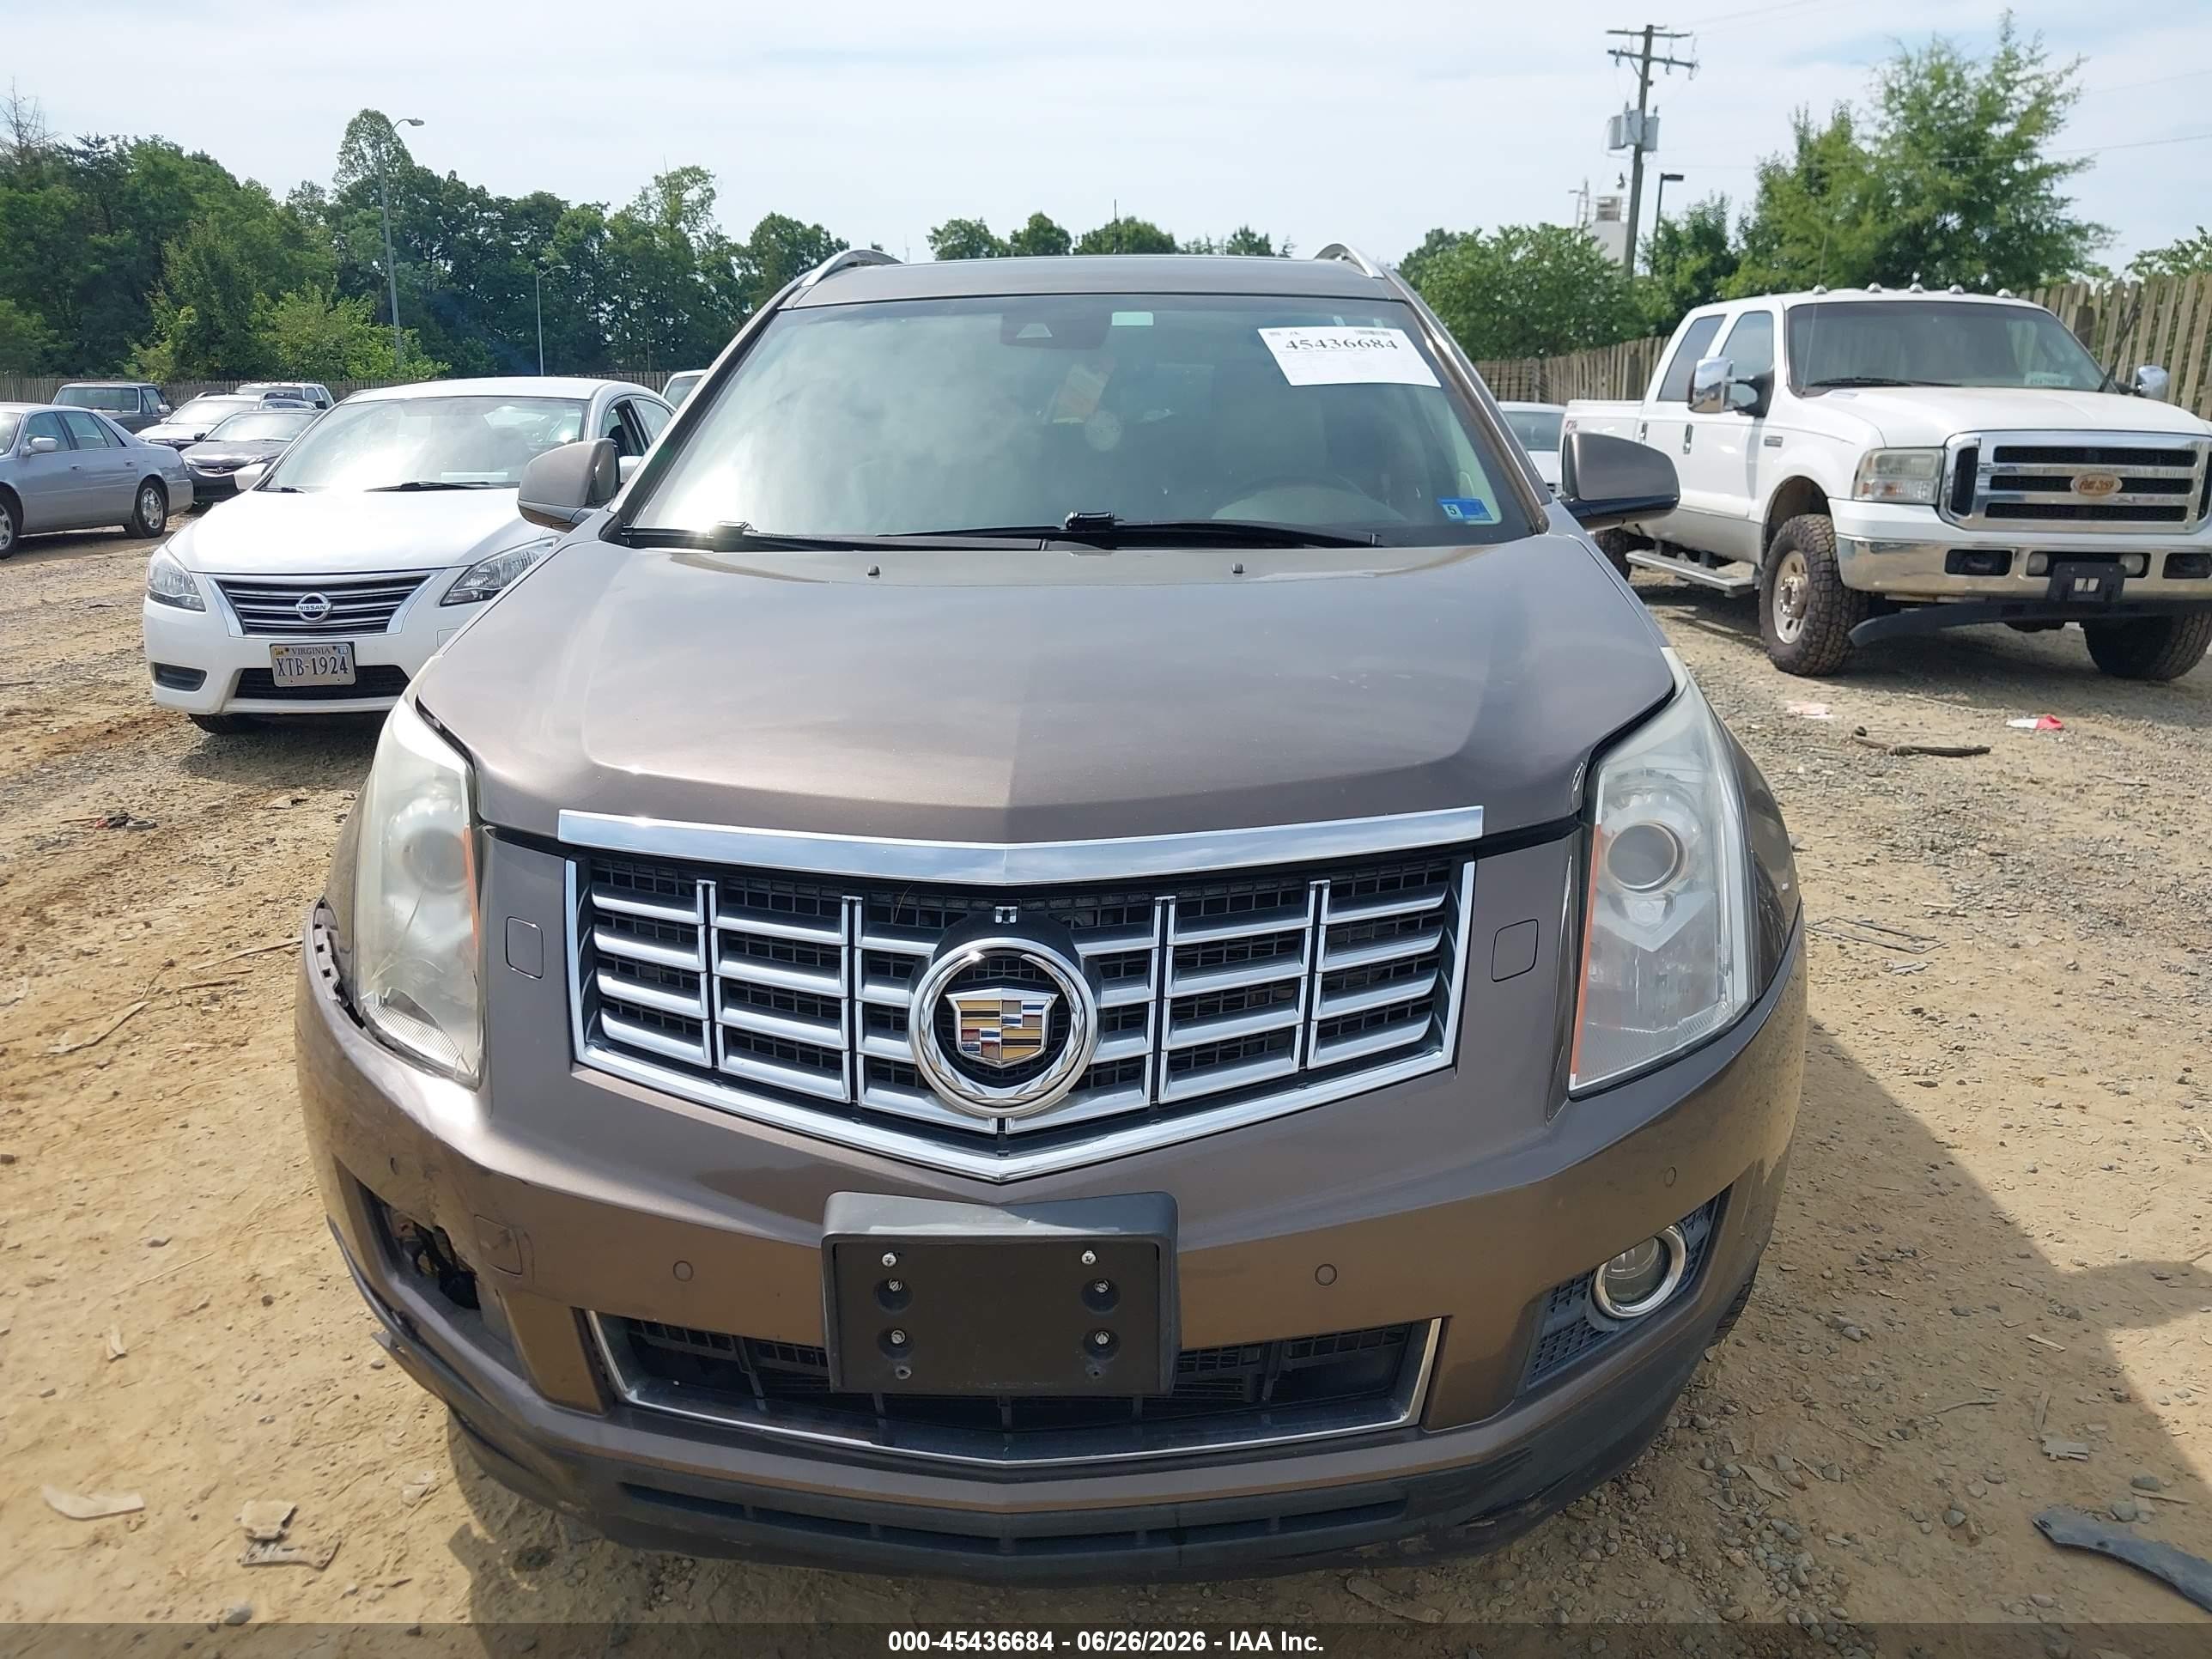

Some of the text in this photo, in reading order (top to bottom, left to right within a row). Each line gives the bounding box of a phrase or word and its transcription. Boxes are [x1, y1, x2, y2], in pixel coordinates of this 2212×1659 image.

[1285, 338, 1399, 350] 45436684
[1447, 505, 1457, 515] 5
[291, 647, 331, 655] VIRGINIA
[276, 656, 348, 676] XTB-1924
